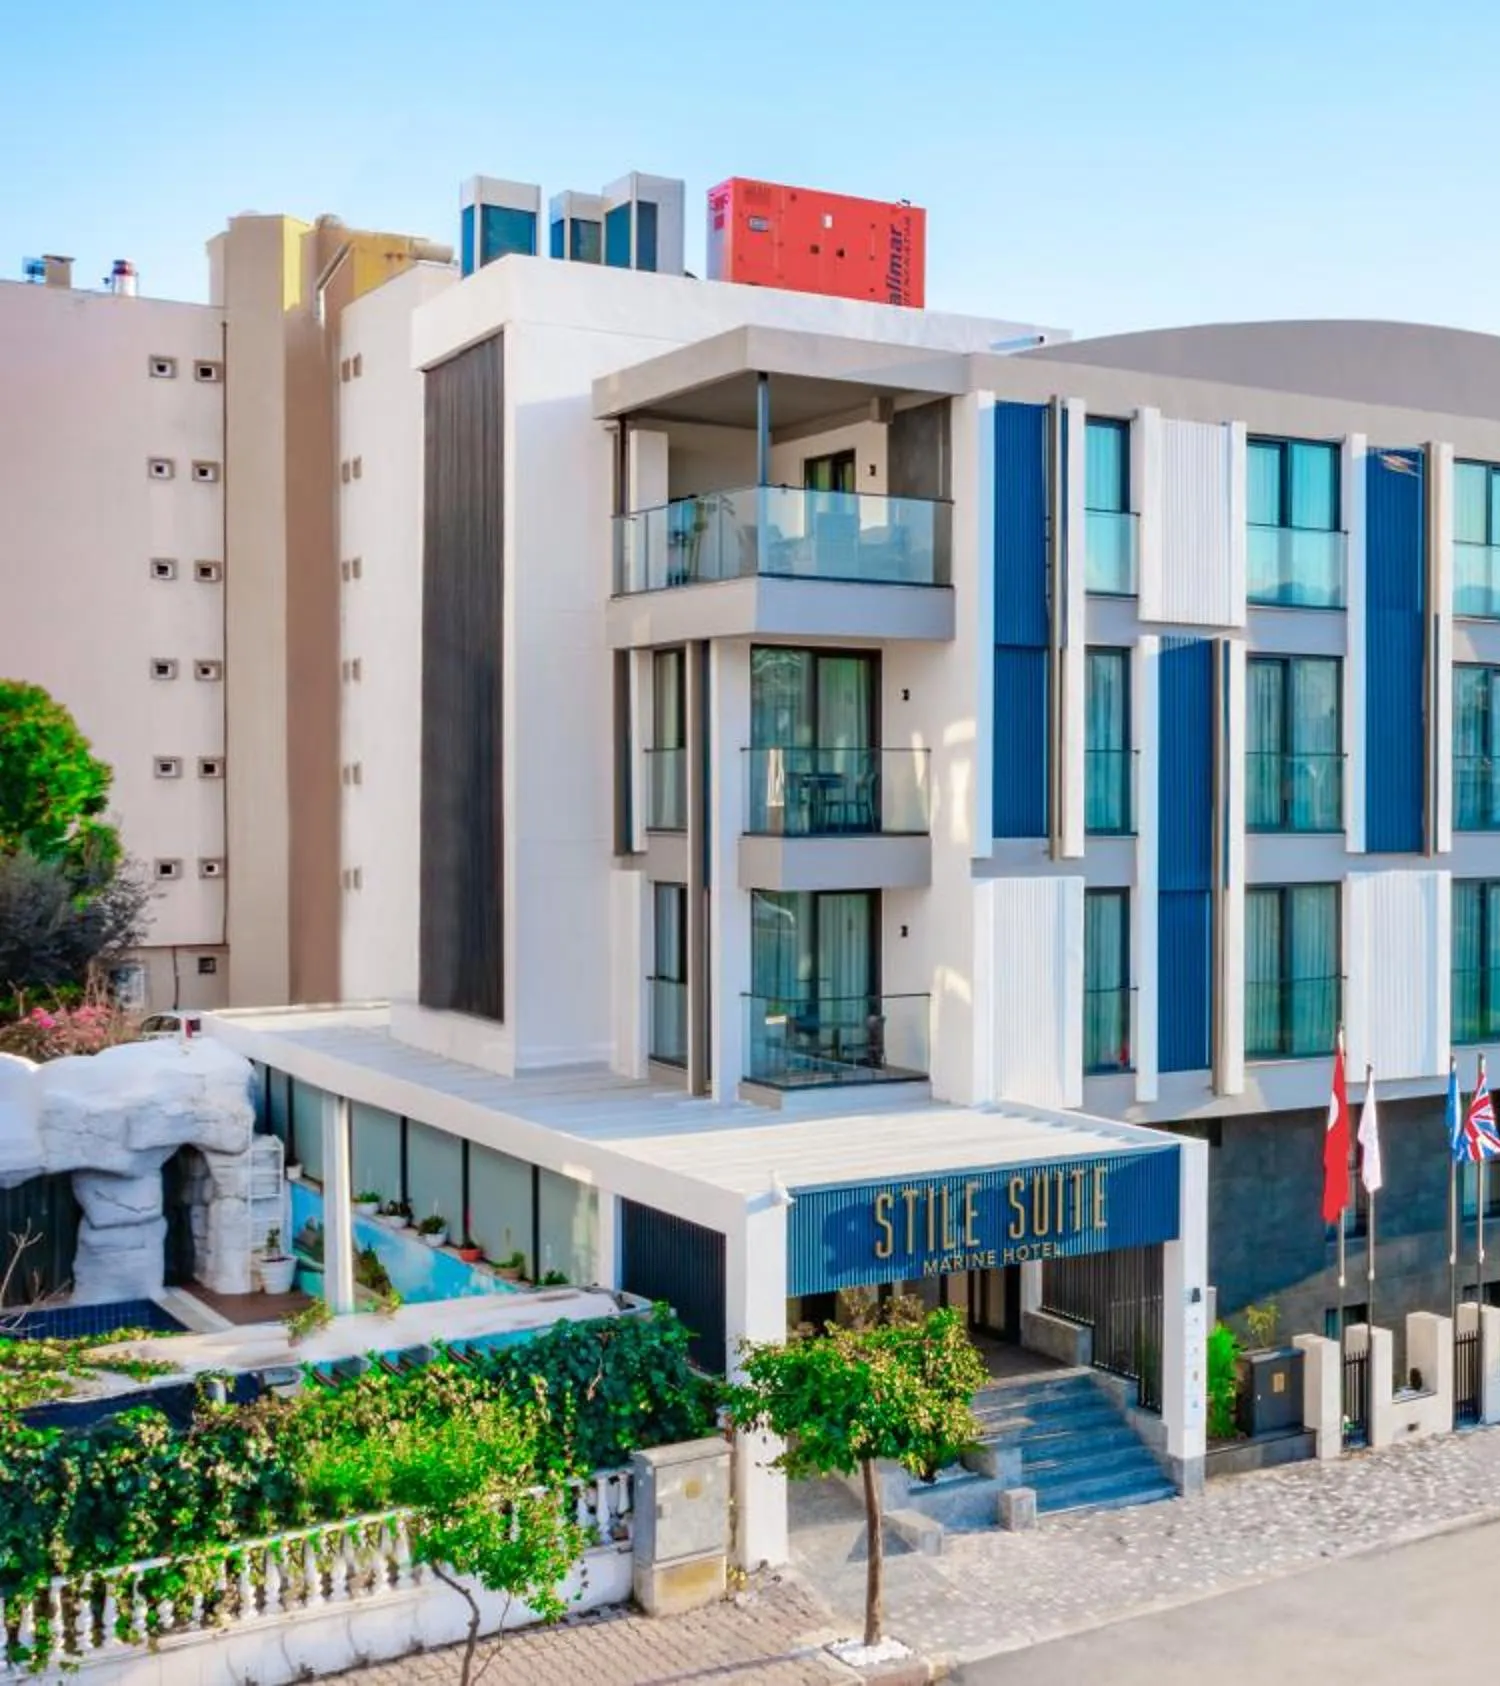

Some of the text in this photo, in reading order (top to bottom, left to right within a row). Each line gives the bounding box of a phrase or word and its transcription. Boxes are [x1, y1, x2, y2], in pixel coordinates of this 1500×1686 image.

[875, 1166, 1108, 1258] STILE SUITE
[923, 1242, 1061, 1276] MARINE HOTEL
